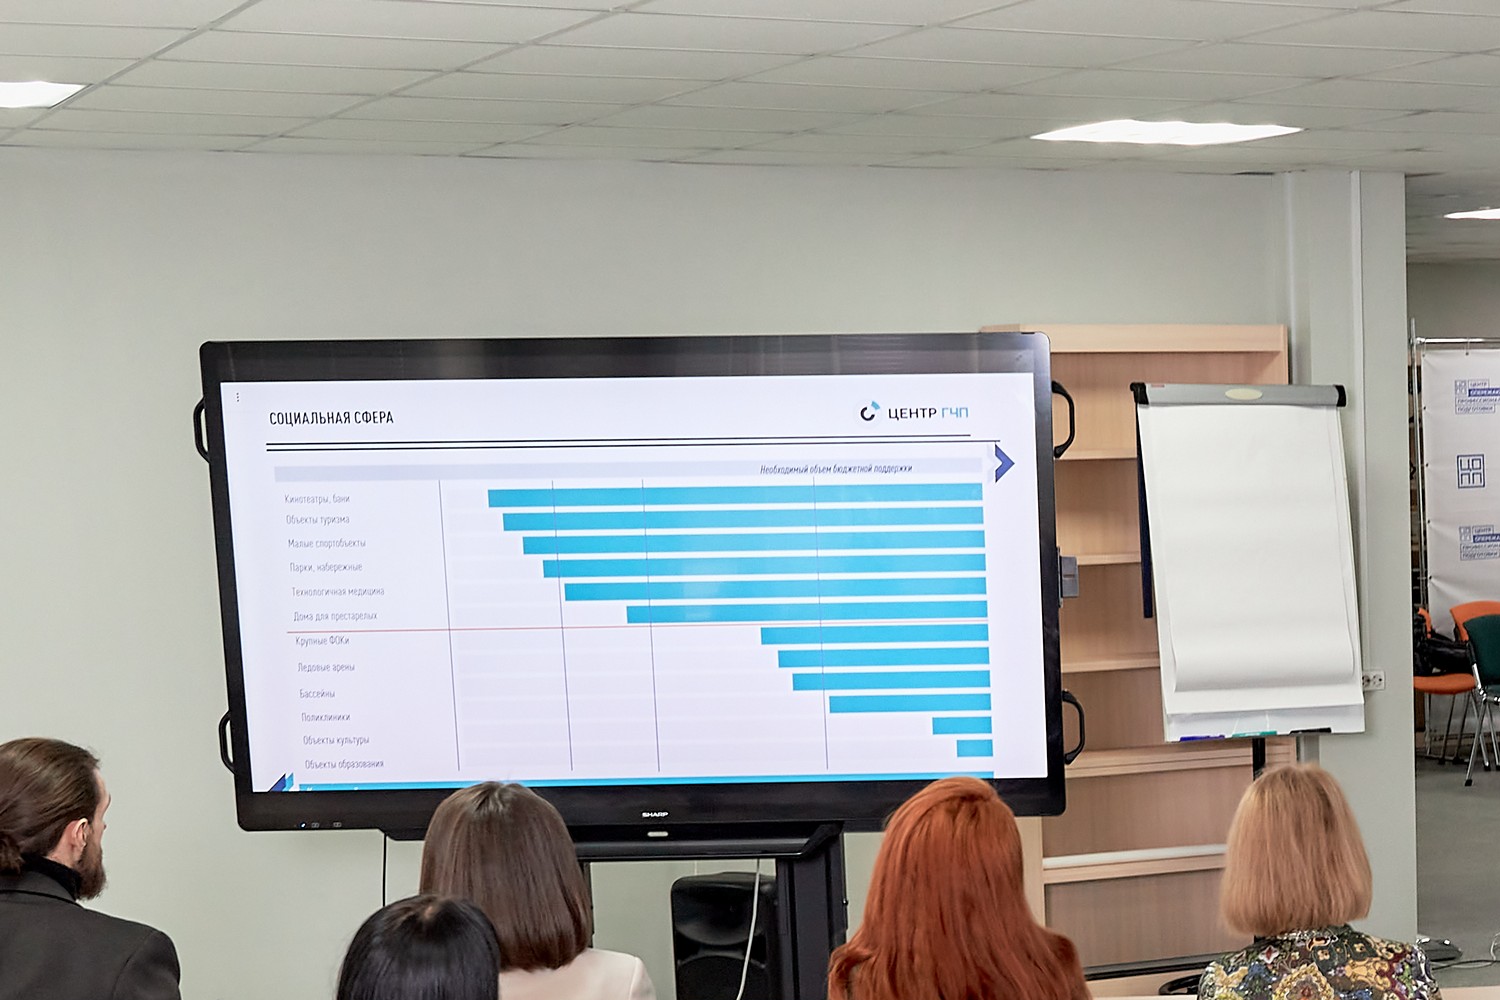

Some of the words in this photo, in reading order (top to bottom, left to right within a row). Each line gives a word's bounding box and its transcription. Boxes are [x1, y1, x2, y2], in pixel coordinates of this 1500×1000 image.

[269, 411, 351, 427] СОЦИАЛЬНАЯ
[354, 410, 394, 425] СФЕРА
[888, 407, 937, 420] ЦЕНТР
[941, 407, 969, 419] ГЧП
[760, 465, 809, 475] Необходимый
[810, 464, 832, 474] объем
[833, 464, 873, 475] бюджетной
[874, 464, 913, 474] поддержки
[284, 494, 332, 505] Кинотеатры,
[332, 493, 351, 504] бани
[286, 514, 318, 525] Объекты
[320, 516, 350, 526] туризма
[288, 539, 314, 548] Малые
[315, 538, 366, 549] спортобъекты
[289, 562, 316, 573] Парки,
[316, 562, 363, 573] набережные
[292, 586, 347, 597] Технологичная
[348, 587, 385, 597] медицина
[293, 611, 314, 622] Дома
[315, 613, 329, 622] для
[331, 612, 378, 622] престарелых
[295, 636, 328, 647] Крупные
[329, 635, 350, 645] ФОКи
[298, 662, 330, 673] Ледовые
[332, 663, 356, 673] арены
[299, 689, 336, 699] Бассейны
[301, 712, 351, 722] Поликлиники
[303, 735, 335, 745] Объекты
[336, 736, 370, 747] культуры
[305, 760, 337, 770] Объекты
[338, 759, 384, 770] образования
